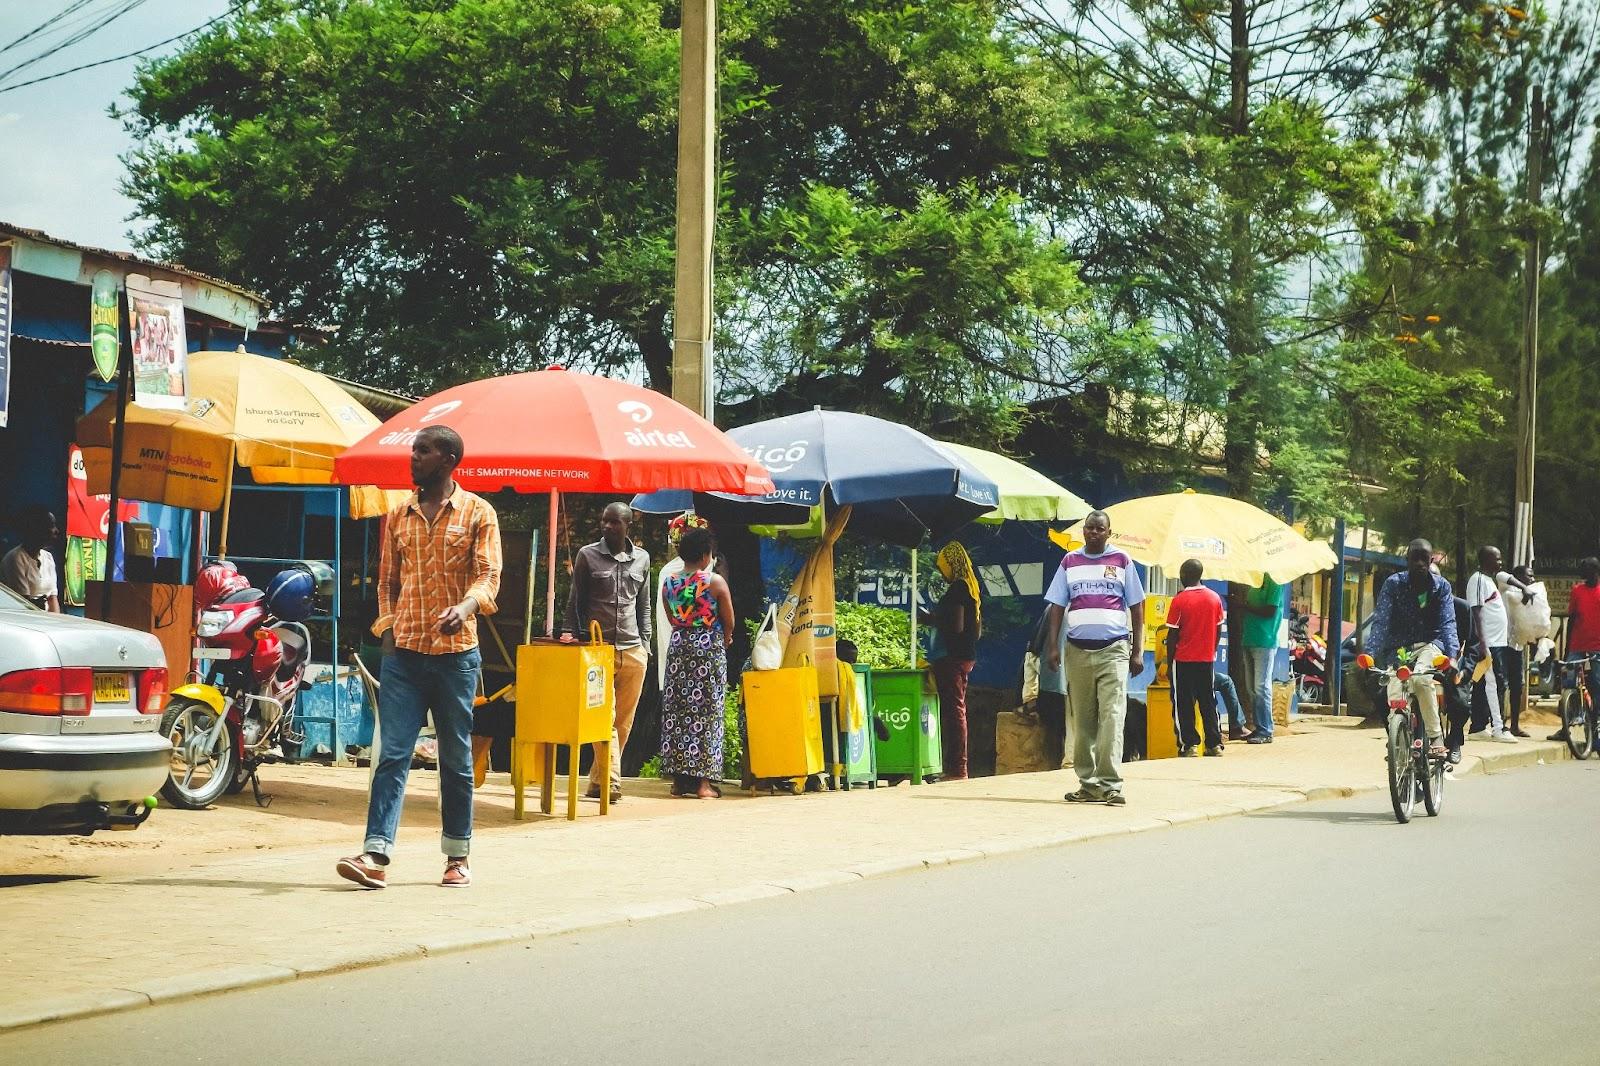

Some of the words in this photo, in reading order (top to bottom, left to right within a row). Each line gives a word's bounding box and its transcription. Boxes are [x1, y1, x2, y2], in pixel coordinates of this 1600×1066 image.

[274, 408, 320, 418] StarTimes
[624, 428, 696, 449] airtel
[139, 447, 164, 460] MTN
[457, 468, 474, 477] THE
[476, 468, 542, 477] SMARTPHONE
[543, 469, 590, 480] NETWORK
[799, 487, 812, 500] it.
[1072, 582, 1115, 591] ETIHAD
